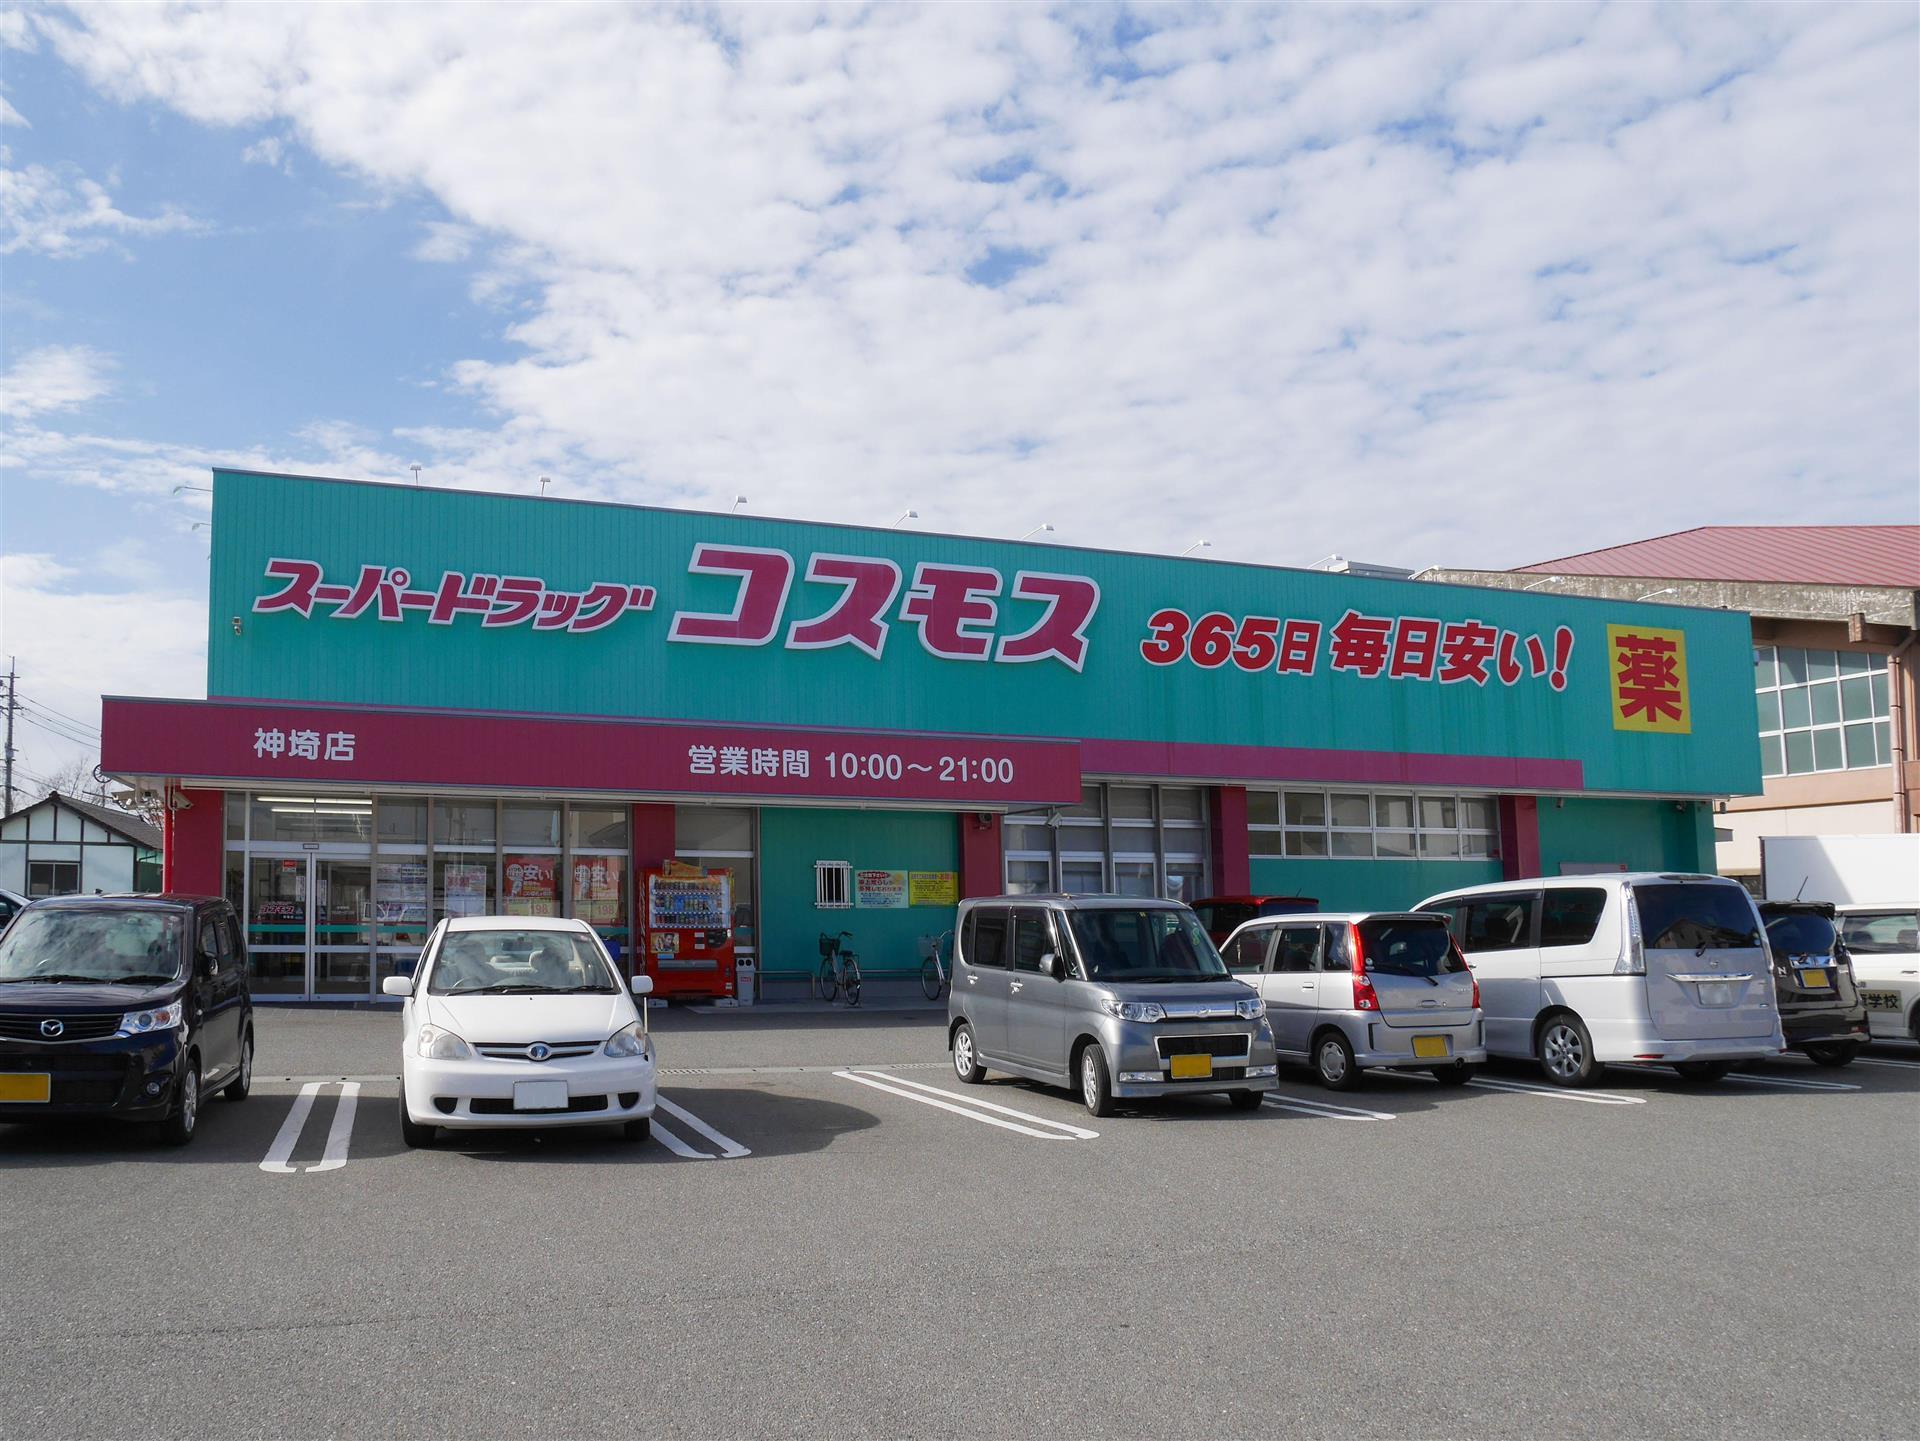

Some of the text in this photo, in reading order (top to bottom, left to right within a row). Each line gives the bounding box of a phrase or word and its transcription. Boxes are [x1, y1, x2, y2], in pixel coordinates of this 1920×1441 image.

[252, 543, 1101, 673] スーパードラッグ コスモス
[1615, 633, 1683, 722] 薬
[253, 727, 356, 761] 神埼店
[688, 745, 810, 778] 営業時間
